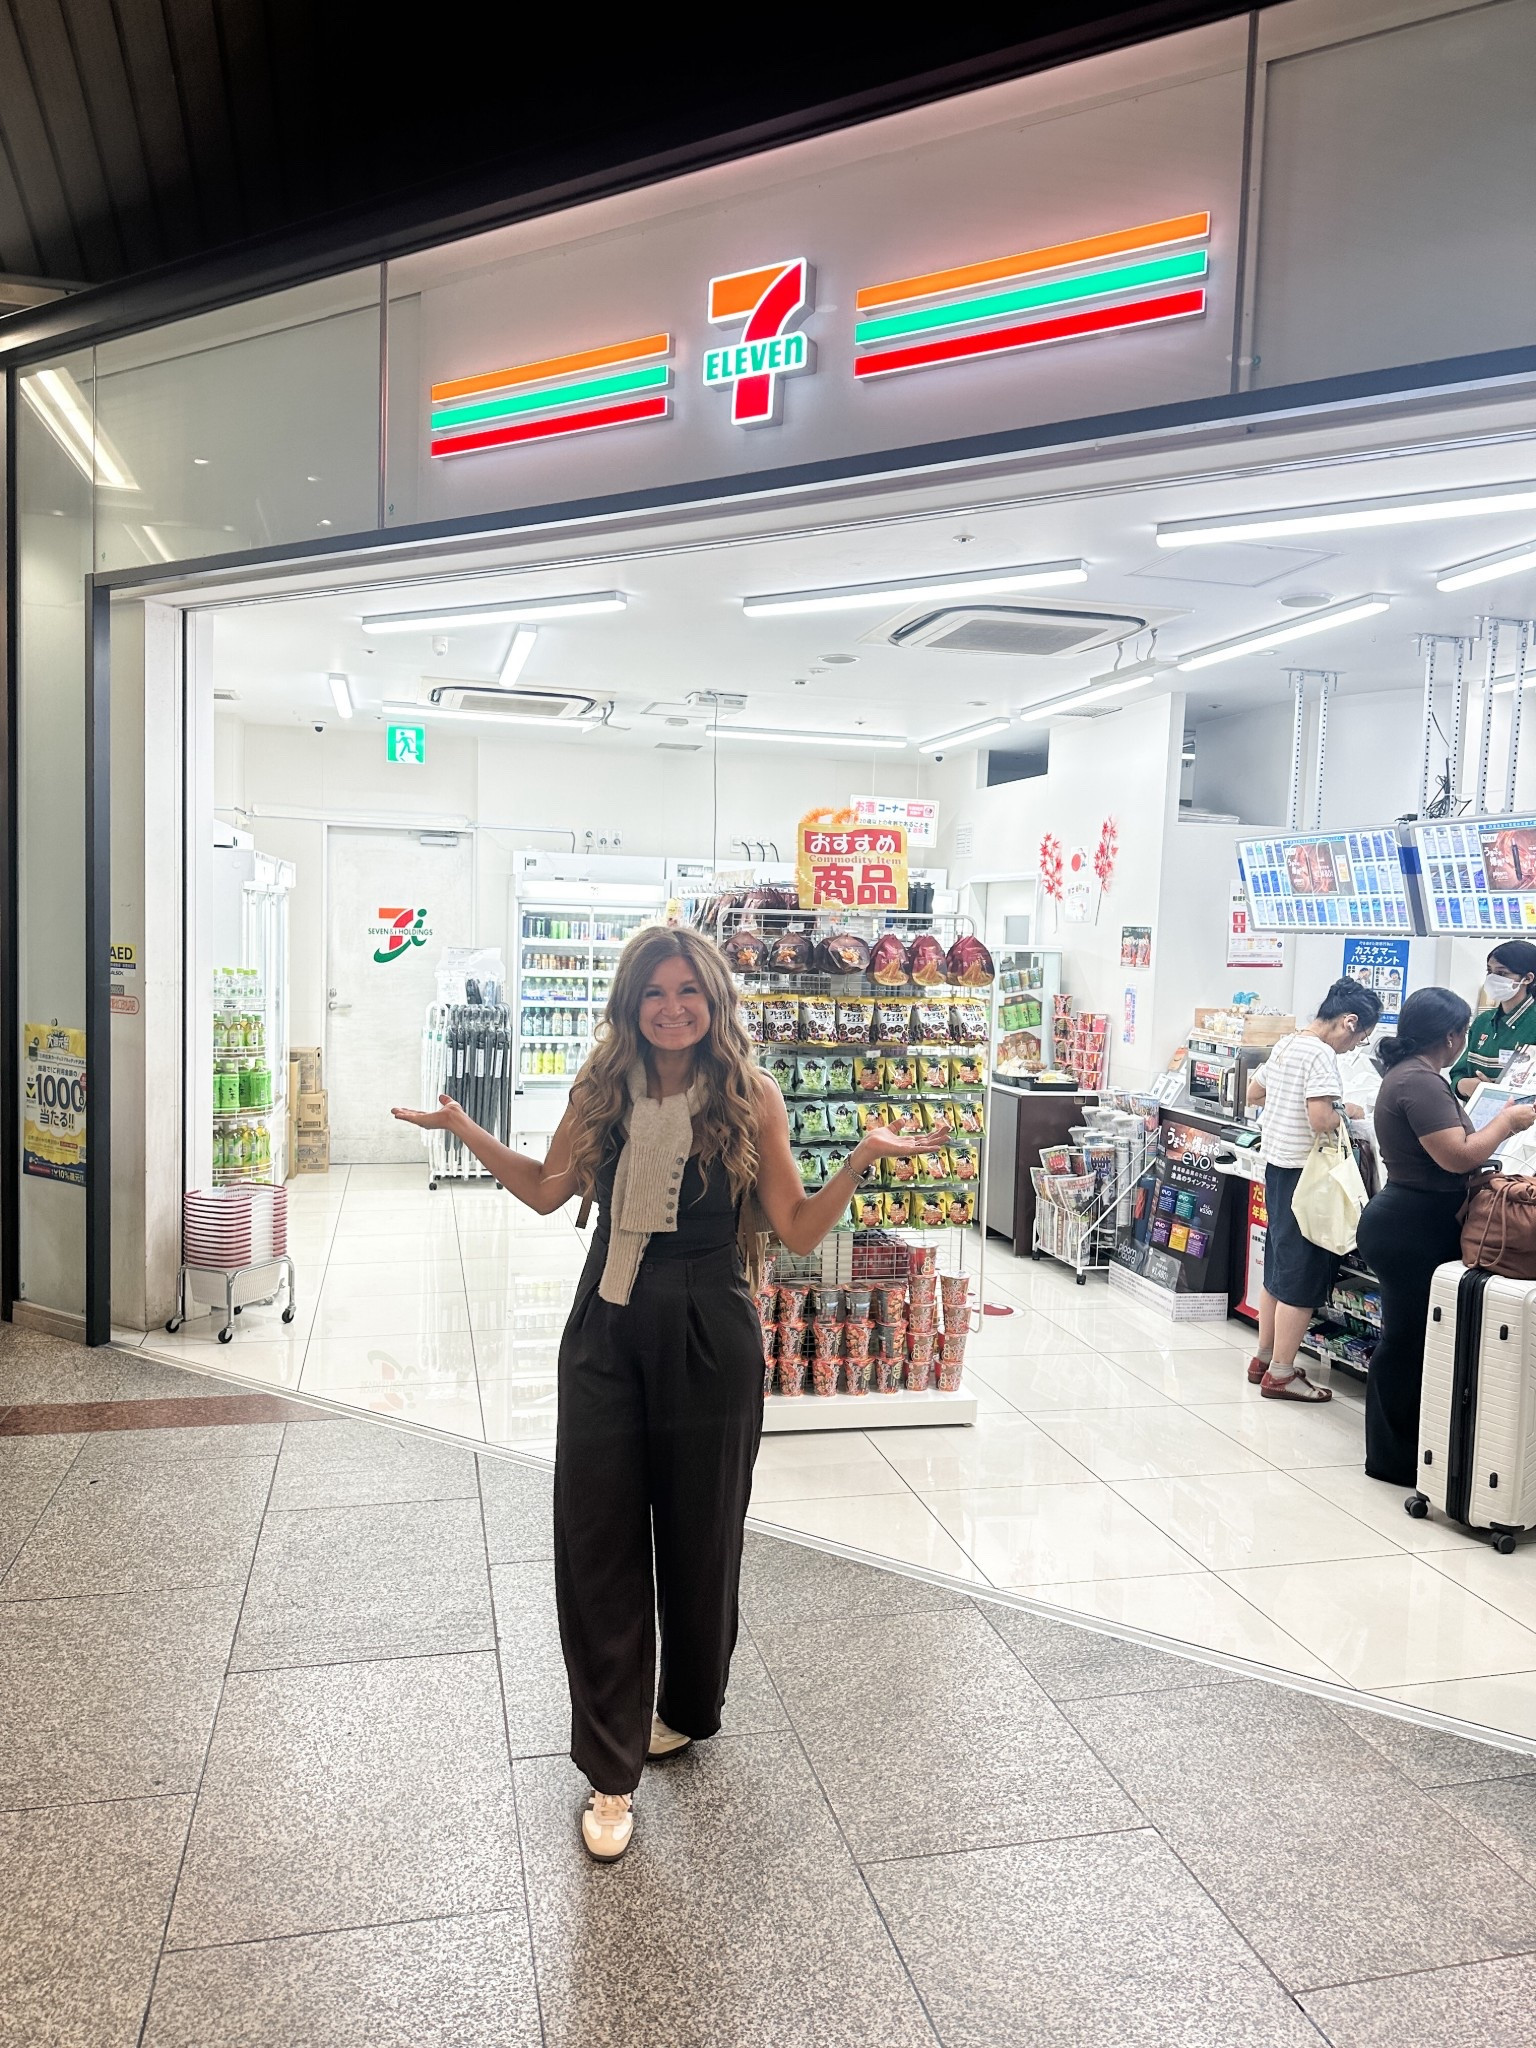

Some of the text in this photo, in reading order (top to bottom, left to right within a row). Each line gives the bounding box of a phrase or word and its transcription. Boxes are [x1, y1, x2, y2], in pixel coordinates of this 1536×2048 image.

[709, 259, 805, 423] 7
[878, 804, 906, 813] コーナー
[810, 833, 896, 854] おすすめ
[808, 855, 902, 866] Commodity Item
[812, 863, 898, 906] 商品
[1355, 946, 1398, 955] カスタマー
[1350, 955, 1400, 965] ハラスメント
[1182, 1151, 1212, 1171] evo
